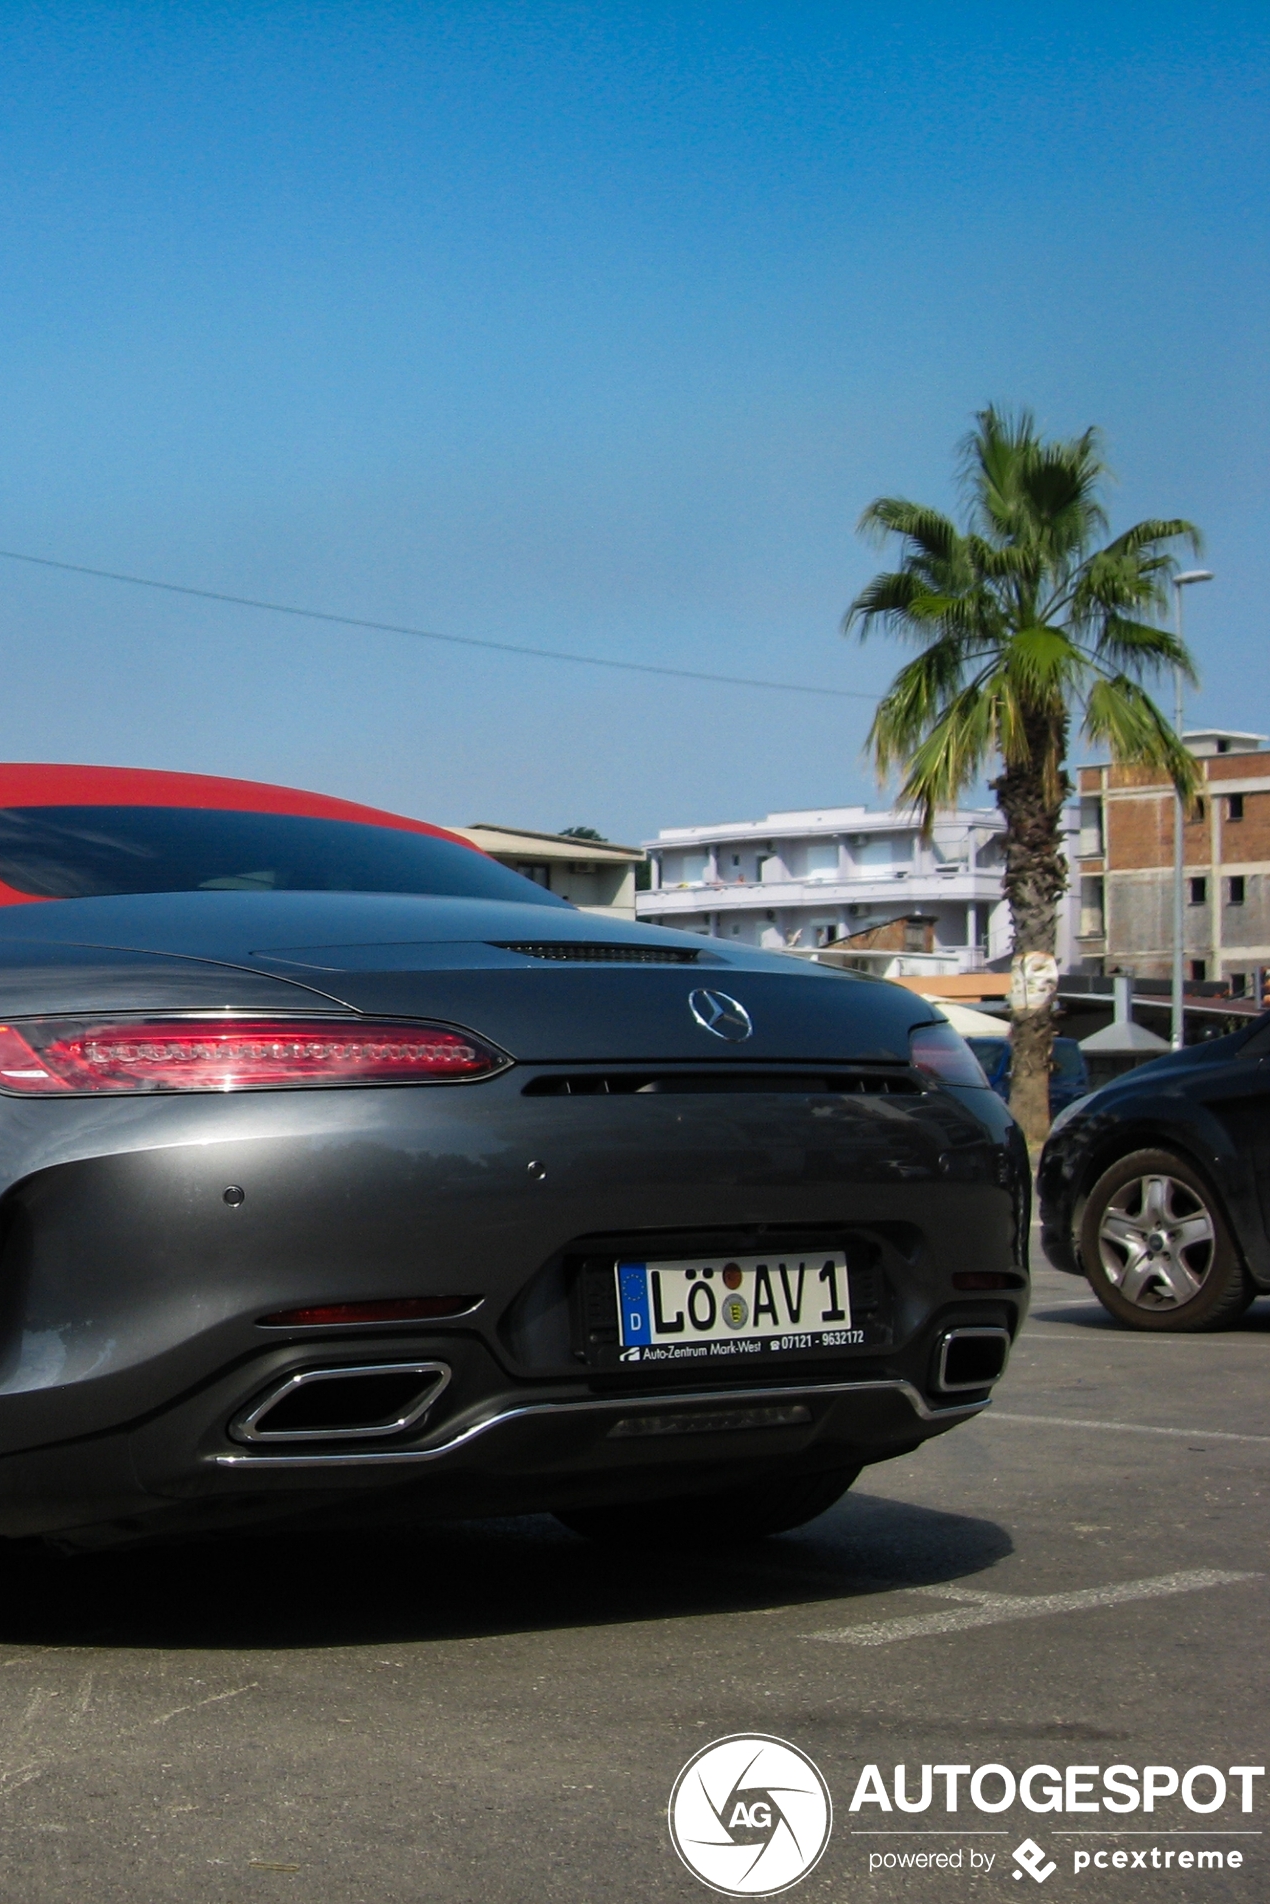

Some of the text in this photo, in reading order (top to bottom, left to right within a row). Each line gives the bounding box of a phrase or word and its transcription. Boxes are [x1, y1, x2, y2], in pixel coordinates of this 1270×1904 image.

[651, 1260, 845, 1334] LÖ AV 1
[630, 1313, 641, 1331] D
[642, 1345, 708, 1360] Auto-Zentrum
[710, 1341, 761, 1356] Mark-West
[782, 1335, 812, 1350] 07121
[822, 1330, 864, 1346] 9632172
